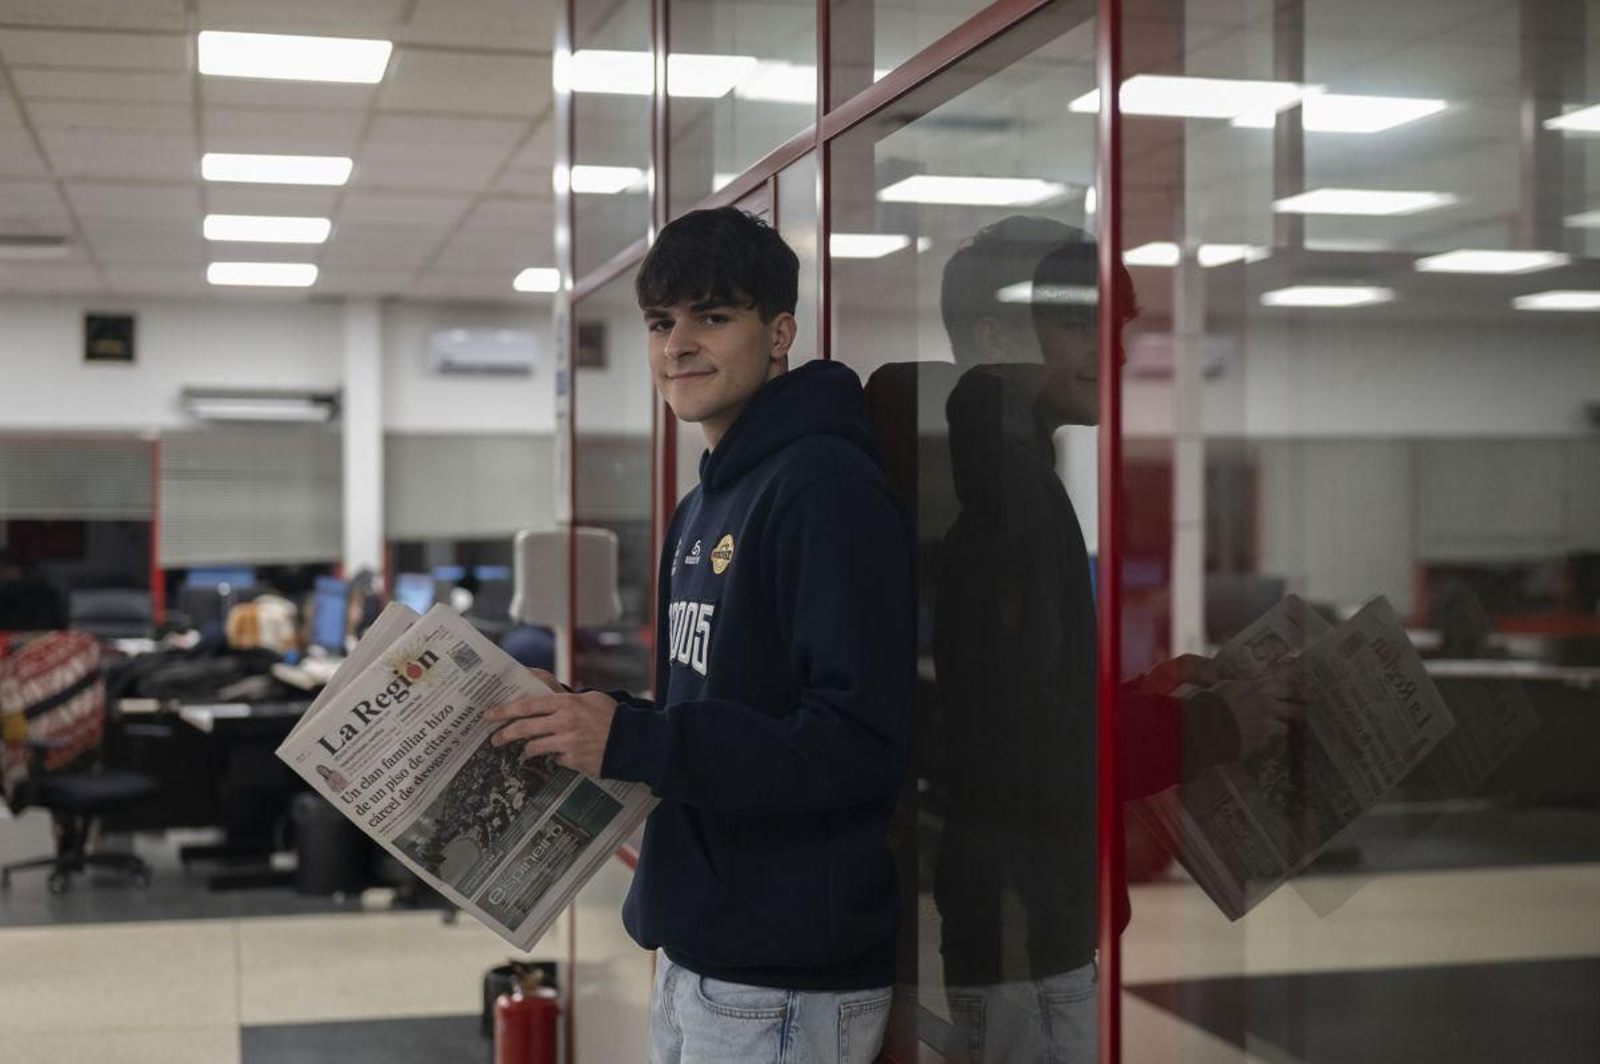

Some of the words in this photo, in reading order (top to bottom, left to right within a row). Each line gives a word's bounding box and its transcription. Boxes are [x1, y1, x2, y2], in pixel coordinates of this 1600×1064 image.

[317, 724, 359, 756] La
[351, 650, 440, 725] Región
[340, 789, 362, 804] Un
[360, 768, 384, 789] clan
[382, 728, 427, 770] familiar
[424, 705, 454, 729] hizo
[355, 802, 371, 816] de
[369, 789, 387, 803] un
[385, 769, 409, 793] piso
[408, 755, 425, 769] de
[424, 728, 453, 755] citas
[451, 706, 475, 728] una
[368, 796, 401, 827] cárcel
[399, 786, 416, 800] de
[414, 747, 453, 785] drogas
